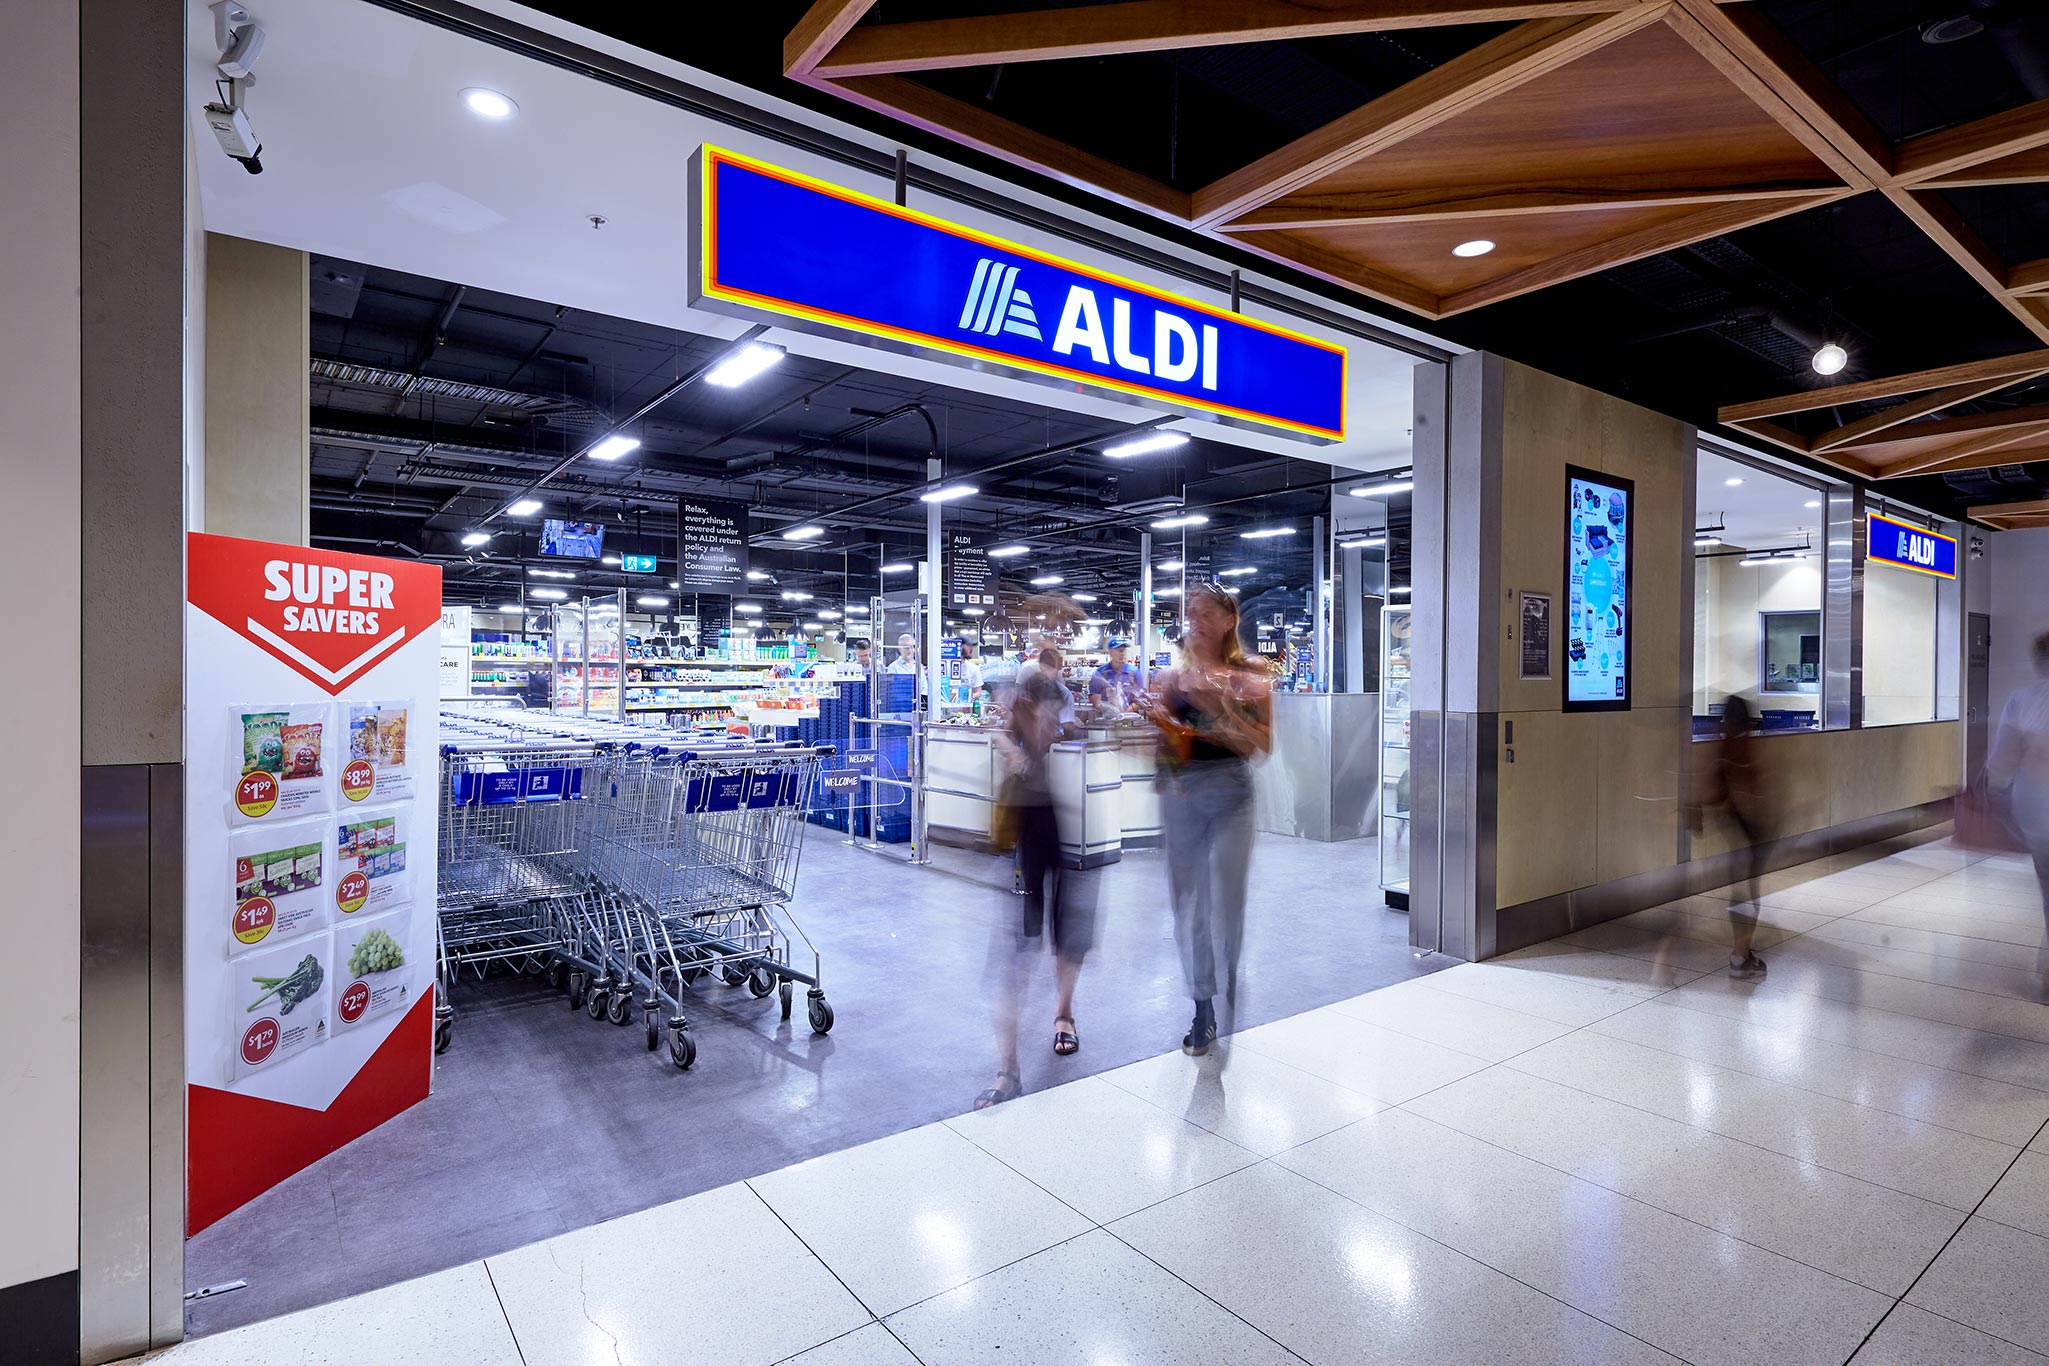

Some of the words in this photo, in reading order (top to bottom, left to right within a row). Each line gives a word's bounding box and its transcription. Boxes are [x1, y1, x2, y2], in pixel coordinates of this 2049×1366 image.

[1052, 284, 1218, 390] ALDI
[685, 505, 708, 514] Relax,
[685, 516, 726, 526] everything
[685, 525, 715, 533] covered
[954, 536, 970, 544] ALDI
[685, 543, 708, 553] policy
[1908, 534, 1935, 566] ALDI
[699, 554, 736, 563] Australian
[685, 562, 723, 571] Consumer
[264, 560, 394, 609] SUPER
[284, 606, 379, 635] SAVERS
[441, 614, 455, 629] RA
[849, 755, 874, 763] WELCOME
[824, 776, 858, 787] WELCOME
[240, 861, 247, 872] 6
